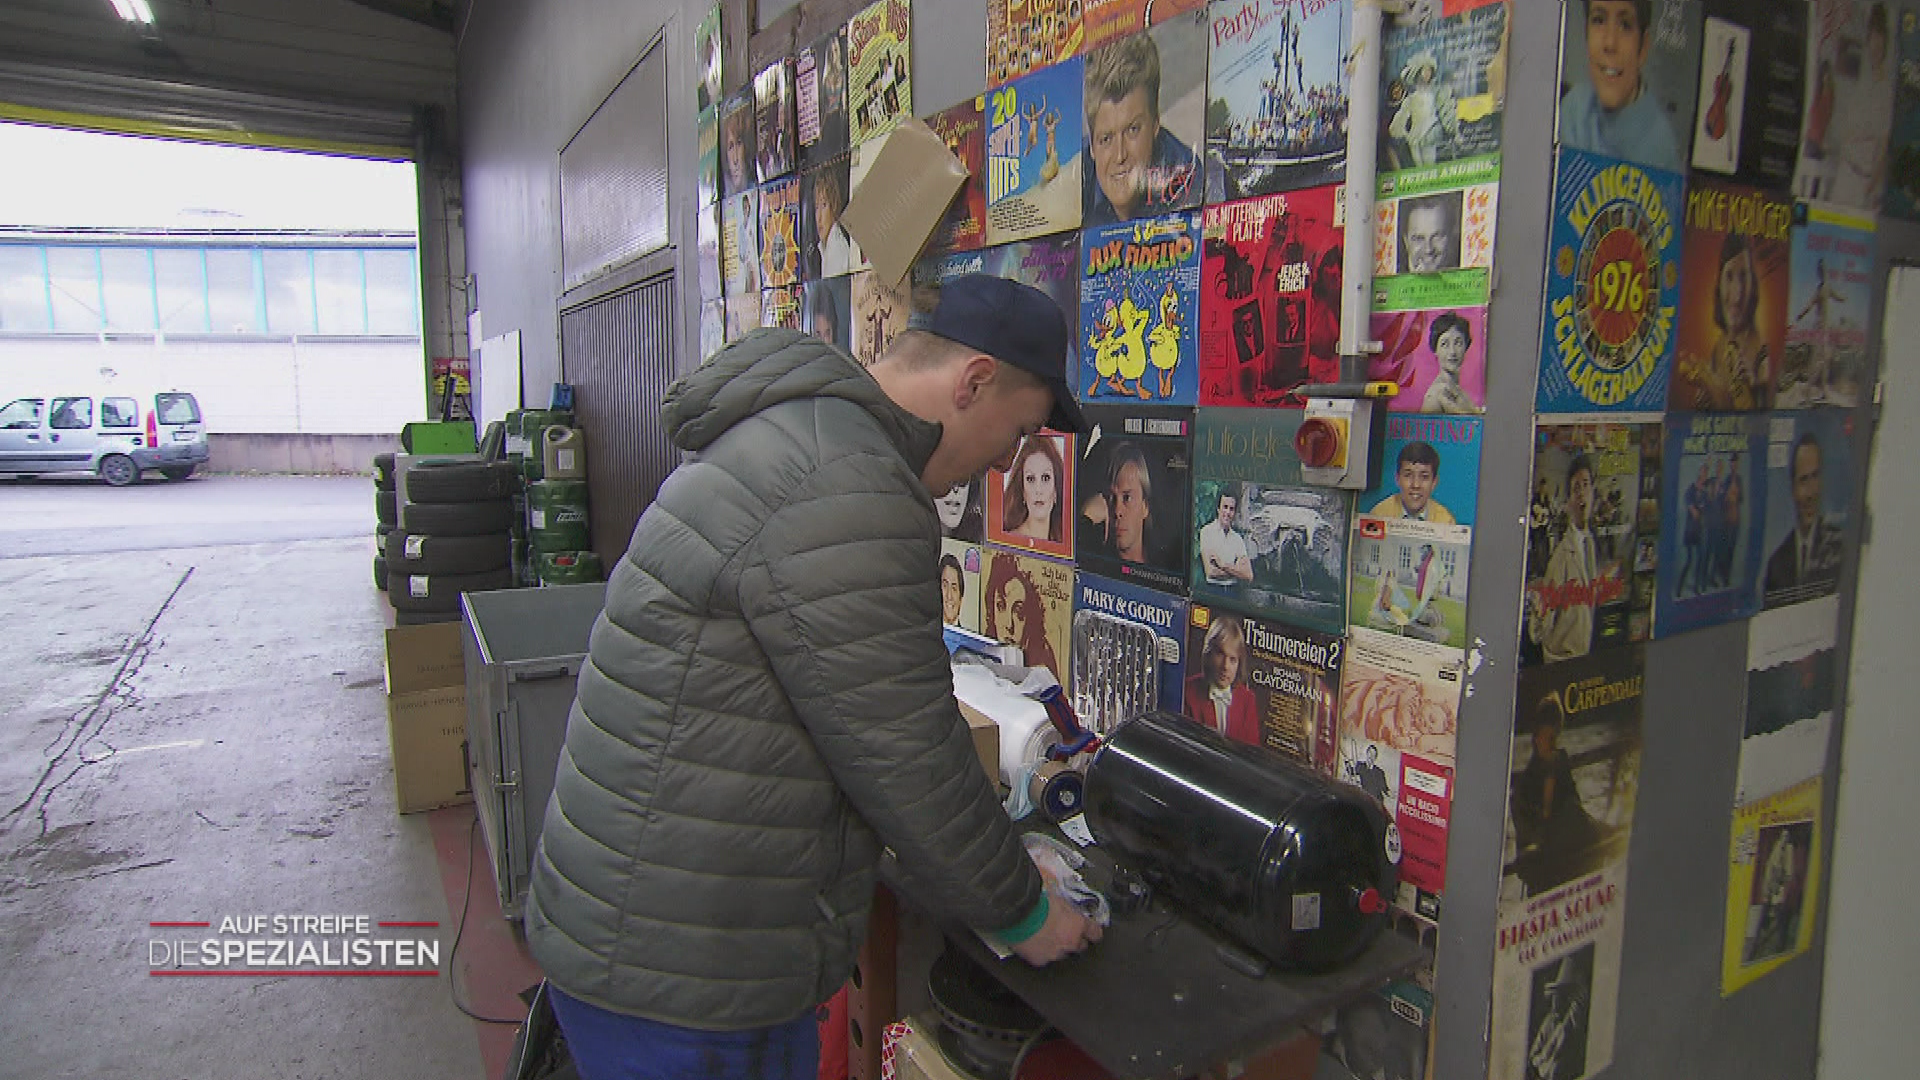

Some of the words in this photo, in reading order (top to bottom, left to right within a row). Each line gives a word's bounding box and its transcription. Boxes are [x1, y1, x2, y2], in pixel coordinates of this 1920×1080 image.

[1213, 0, 1259, 48] Party
[991, 86, 1017, 128] 20
[989, 156, 1020, 206] HITS
[1205, 206, 1219, 228] DIE
[1568, 164, 1673, 249] KLINGENDES
[1685, 188, 1727, 232] MIKE
[1727, 192, 1792, 241] KRÜGER
[1232, 219, 1265, 244] PLATTE
[1279, 276, 1307, 293] ERICH
[1592, 260, 1644, 315] 1976
[1552, 294, 1676, 406] SCHLAGERALBUM
[1082, 586, 1116, 612] MARY
[1115, 596, 1128, 614] &
[1127, 600, 1175, 628] GORDY
[1243, 618, 1327, 670] Träumereien
[1327, 642, 1340, 670] 2
[1252, 669, 1323, 702] CLAYDERMAN
[1563, 675, 1642, 714] CARPENDALE
